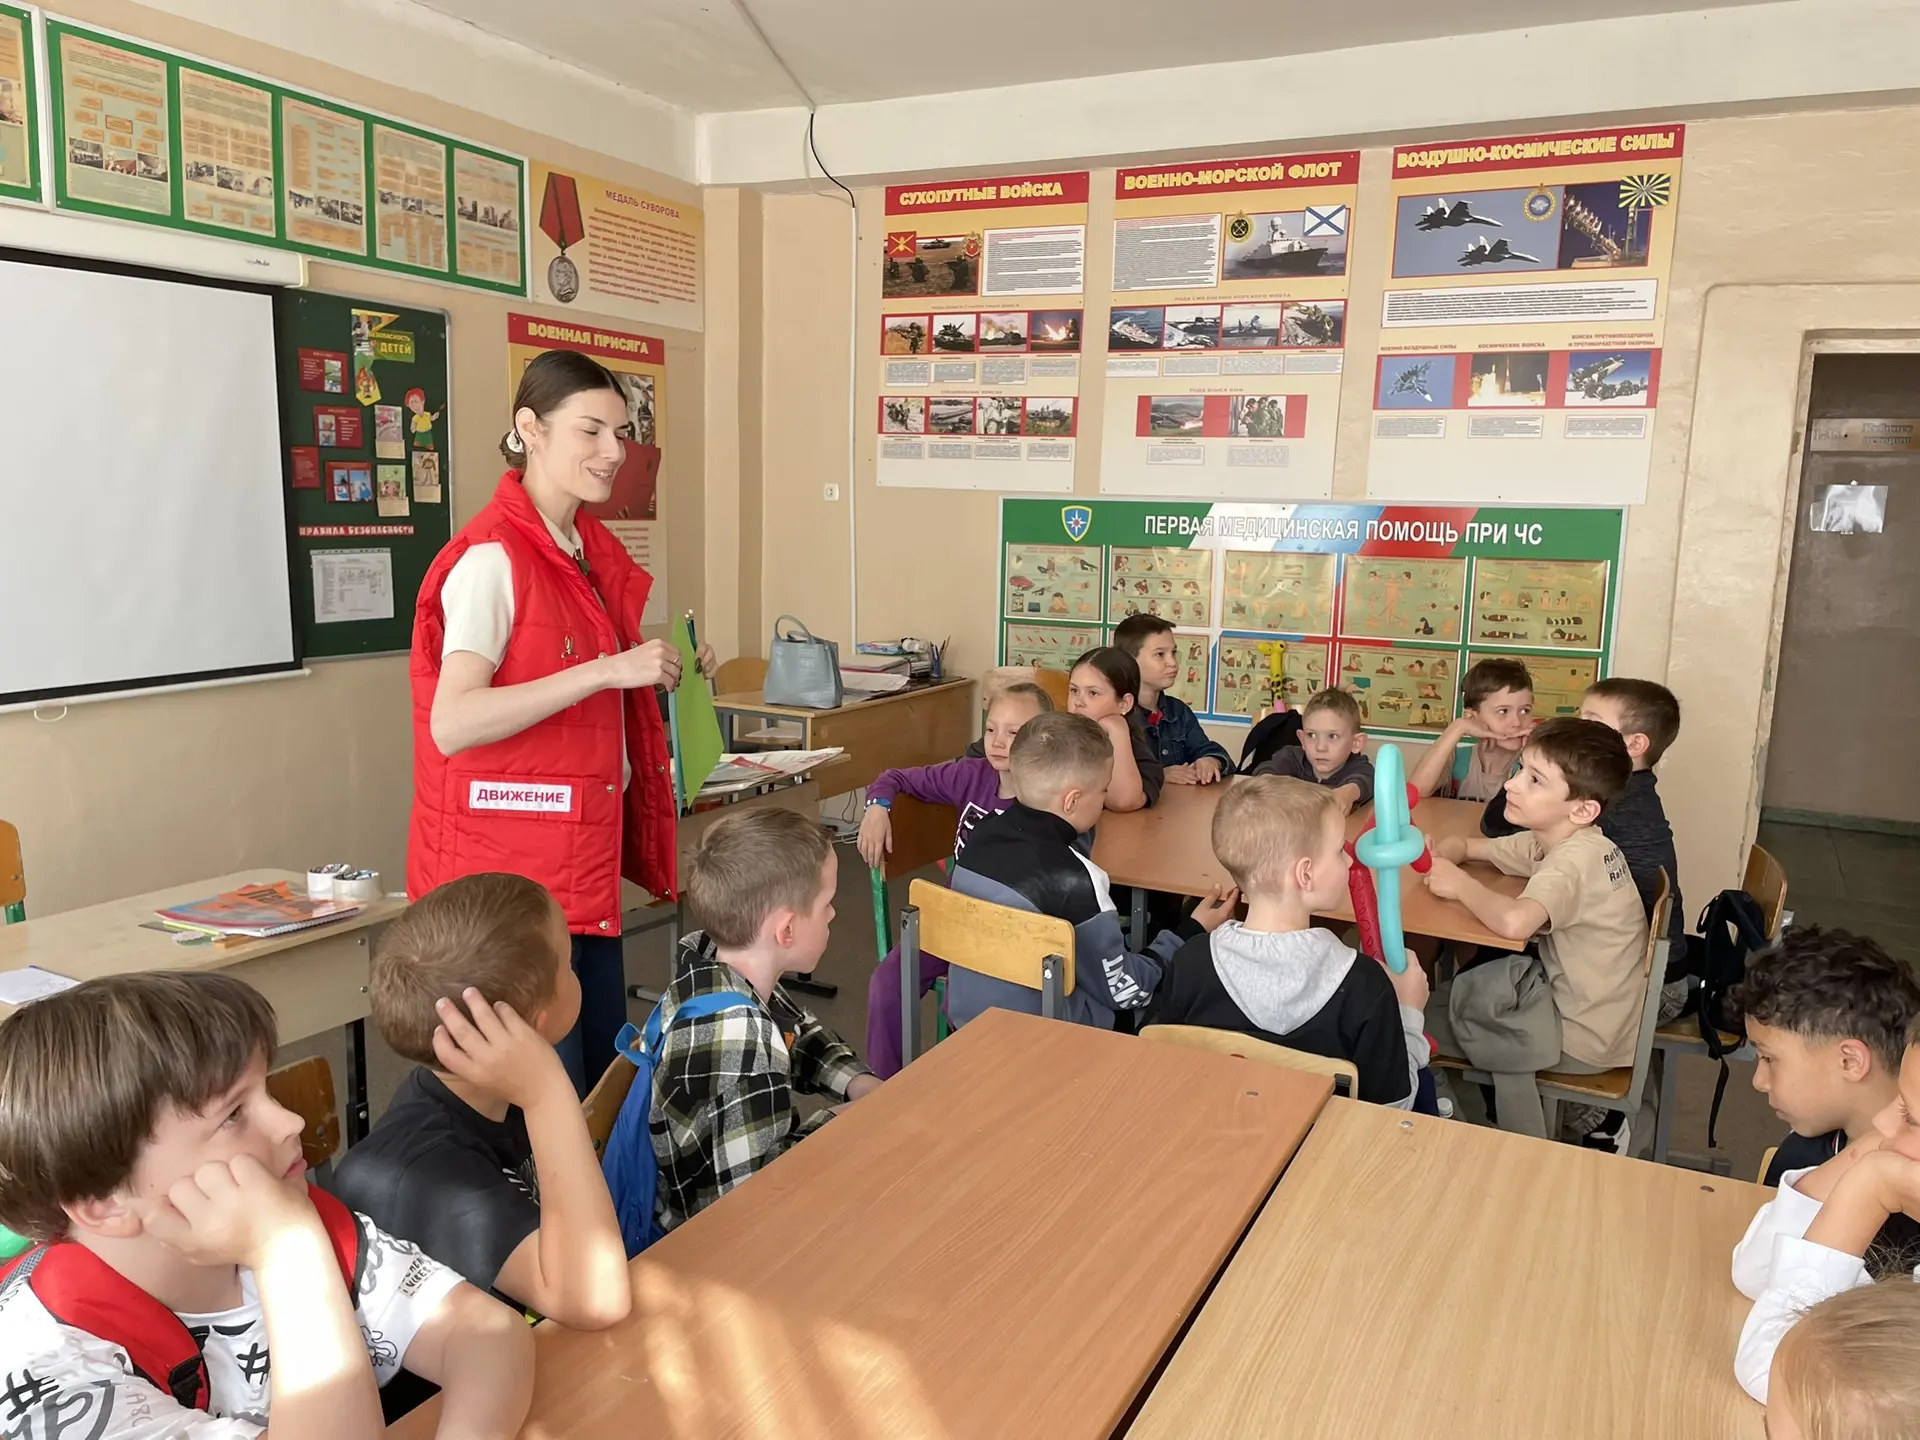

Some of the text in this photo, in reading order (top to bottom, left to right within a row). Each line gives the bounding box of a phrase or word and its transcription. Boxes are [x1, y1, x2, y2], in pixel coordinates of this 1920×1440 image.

[1397, 132, 1675, 169] ВОЗДУШНО-КОСМИЧЕСКИЕ СИЛЫ
[1124, 162, 1342, 190] ВОЕННО-МОРСКОЙ ФЛОТ
[605, 190, 680, 219] МЕДАЛЬ СУВОРОВА
[900, 181, 1063, 206] СУХОПУТНЫЕ ВОЙСКА
[380, 341, 412, 355] ДЕТЕЙ
[527, 322, 649, 355] ВОЕННАЯ ПРИСЯГА
[299, 525, 415, 536] ПРАВИЛА БЕЗОПАСНОСТИ
[1144, 515, 1543, 545] ПЕРВАЯ МЕДИЦИНСКАЯ ПОМОЩЬ ПРИ ЧС
[476, 788, 566, 804] ДВИЖЕНИЕ
